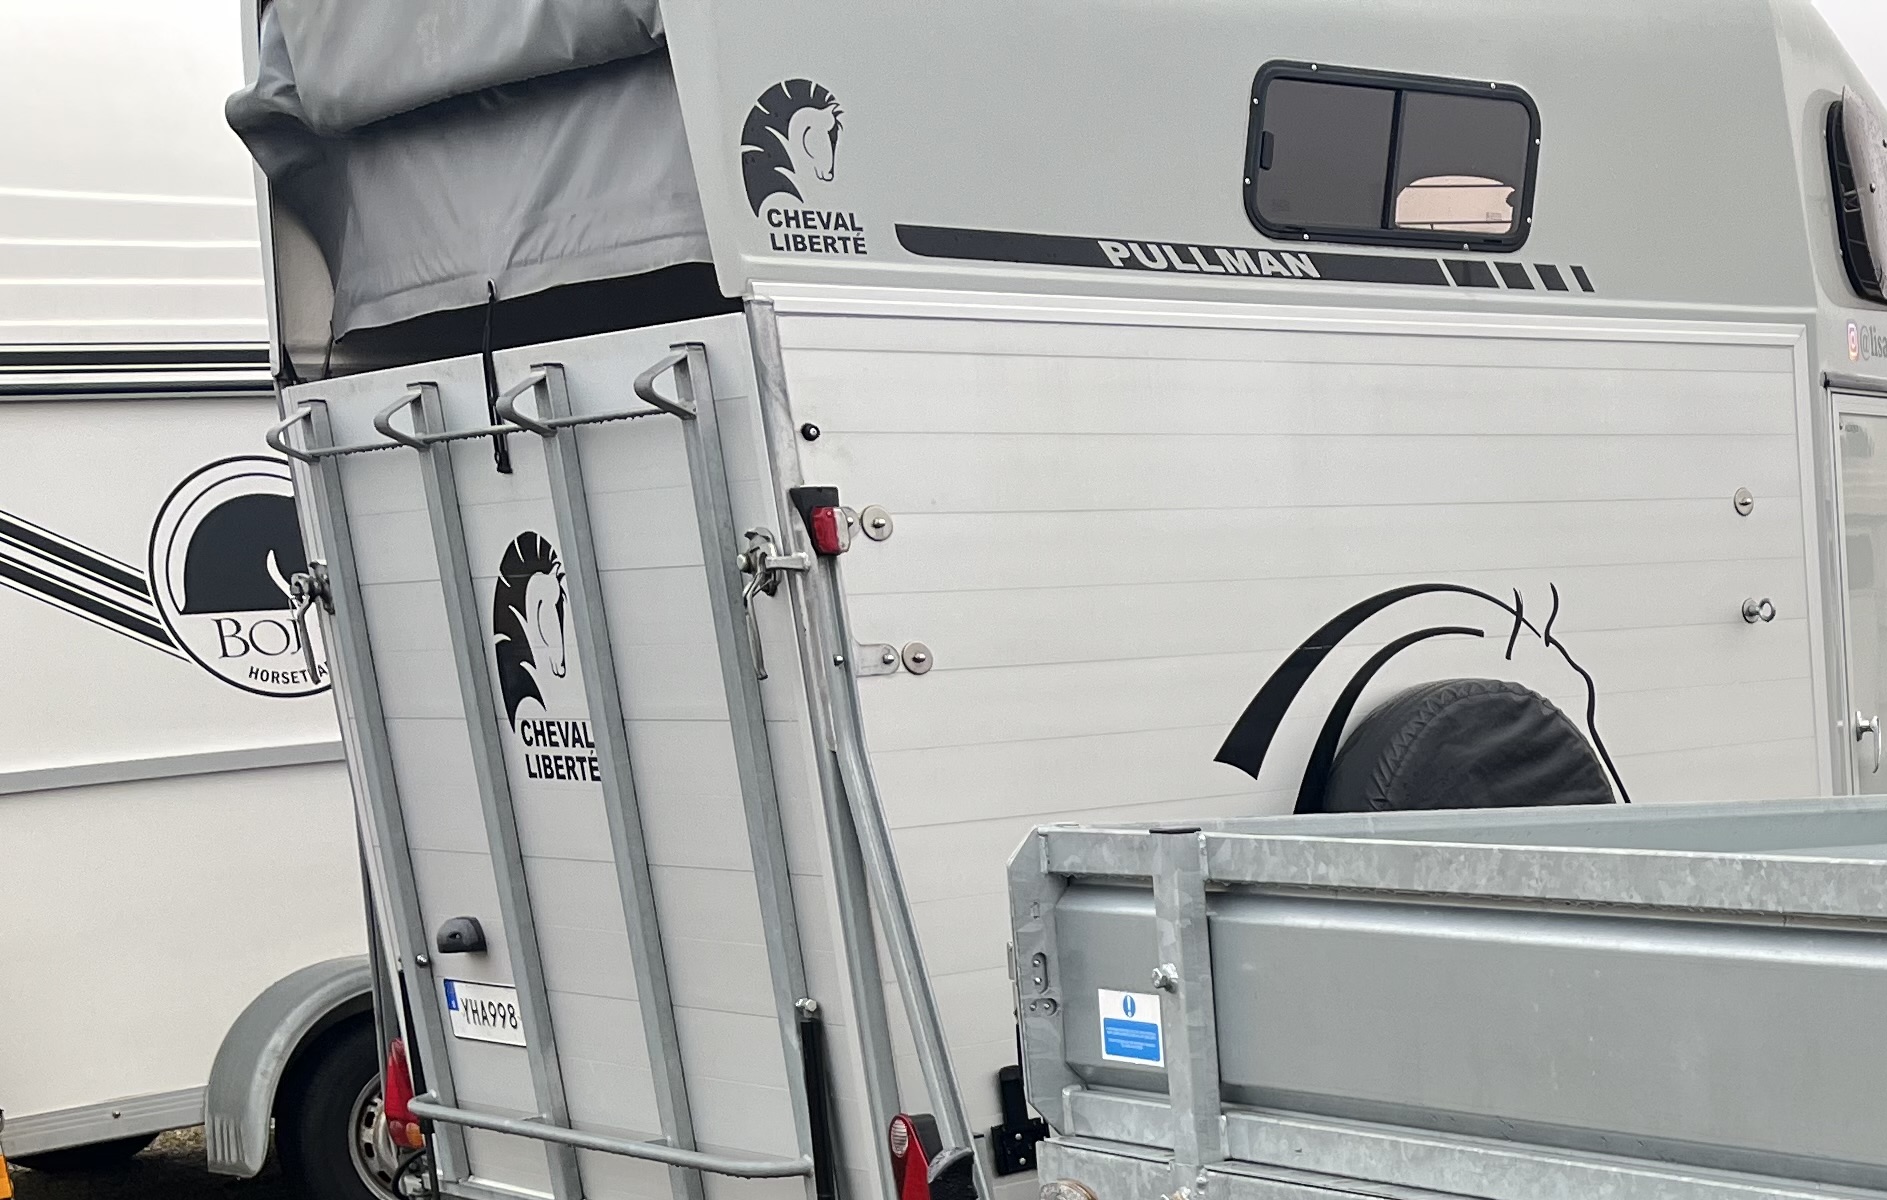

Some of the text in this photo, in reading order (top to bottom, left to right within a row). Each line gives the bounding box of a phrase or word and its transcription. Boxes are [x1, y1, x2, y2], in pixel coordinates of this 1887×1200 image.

[767, 208, 863, 232] CHEVAL
[769, 232, 868, 255] LIBERTÉ
[1097, 240, 1321, 279] PULLMAN
[521, 719, 596, 749] CHEVAL
[525, 749, 602, 782] LIBERTÉ
[460, 997, 519, 1030] YHA998
